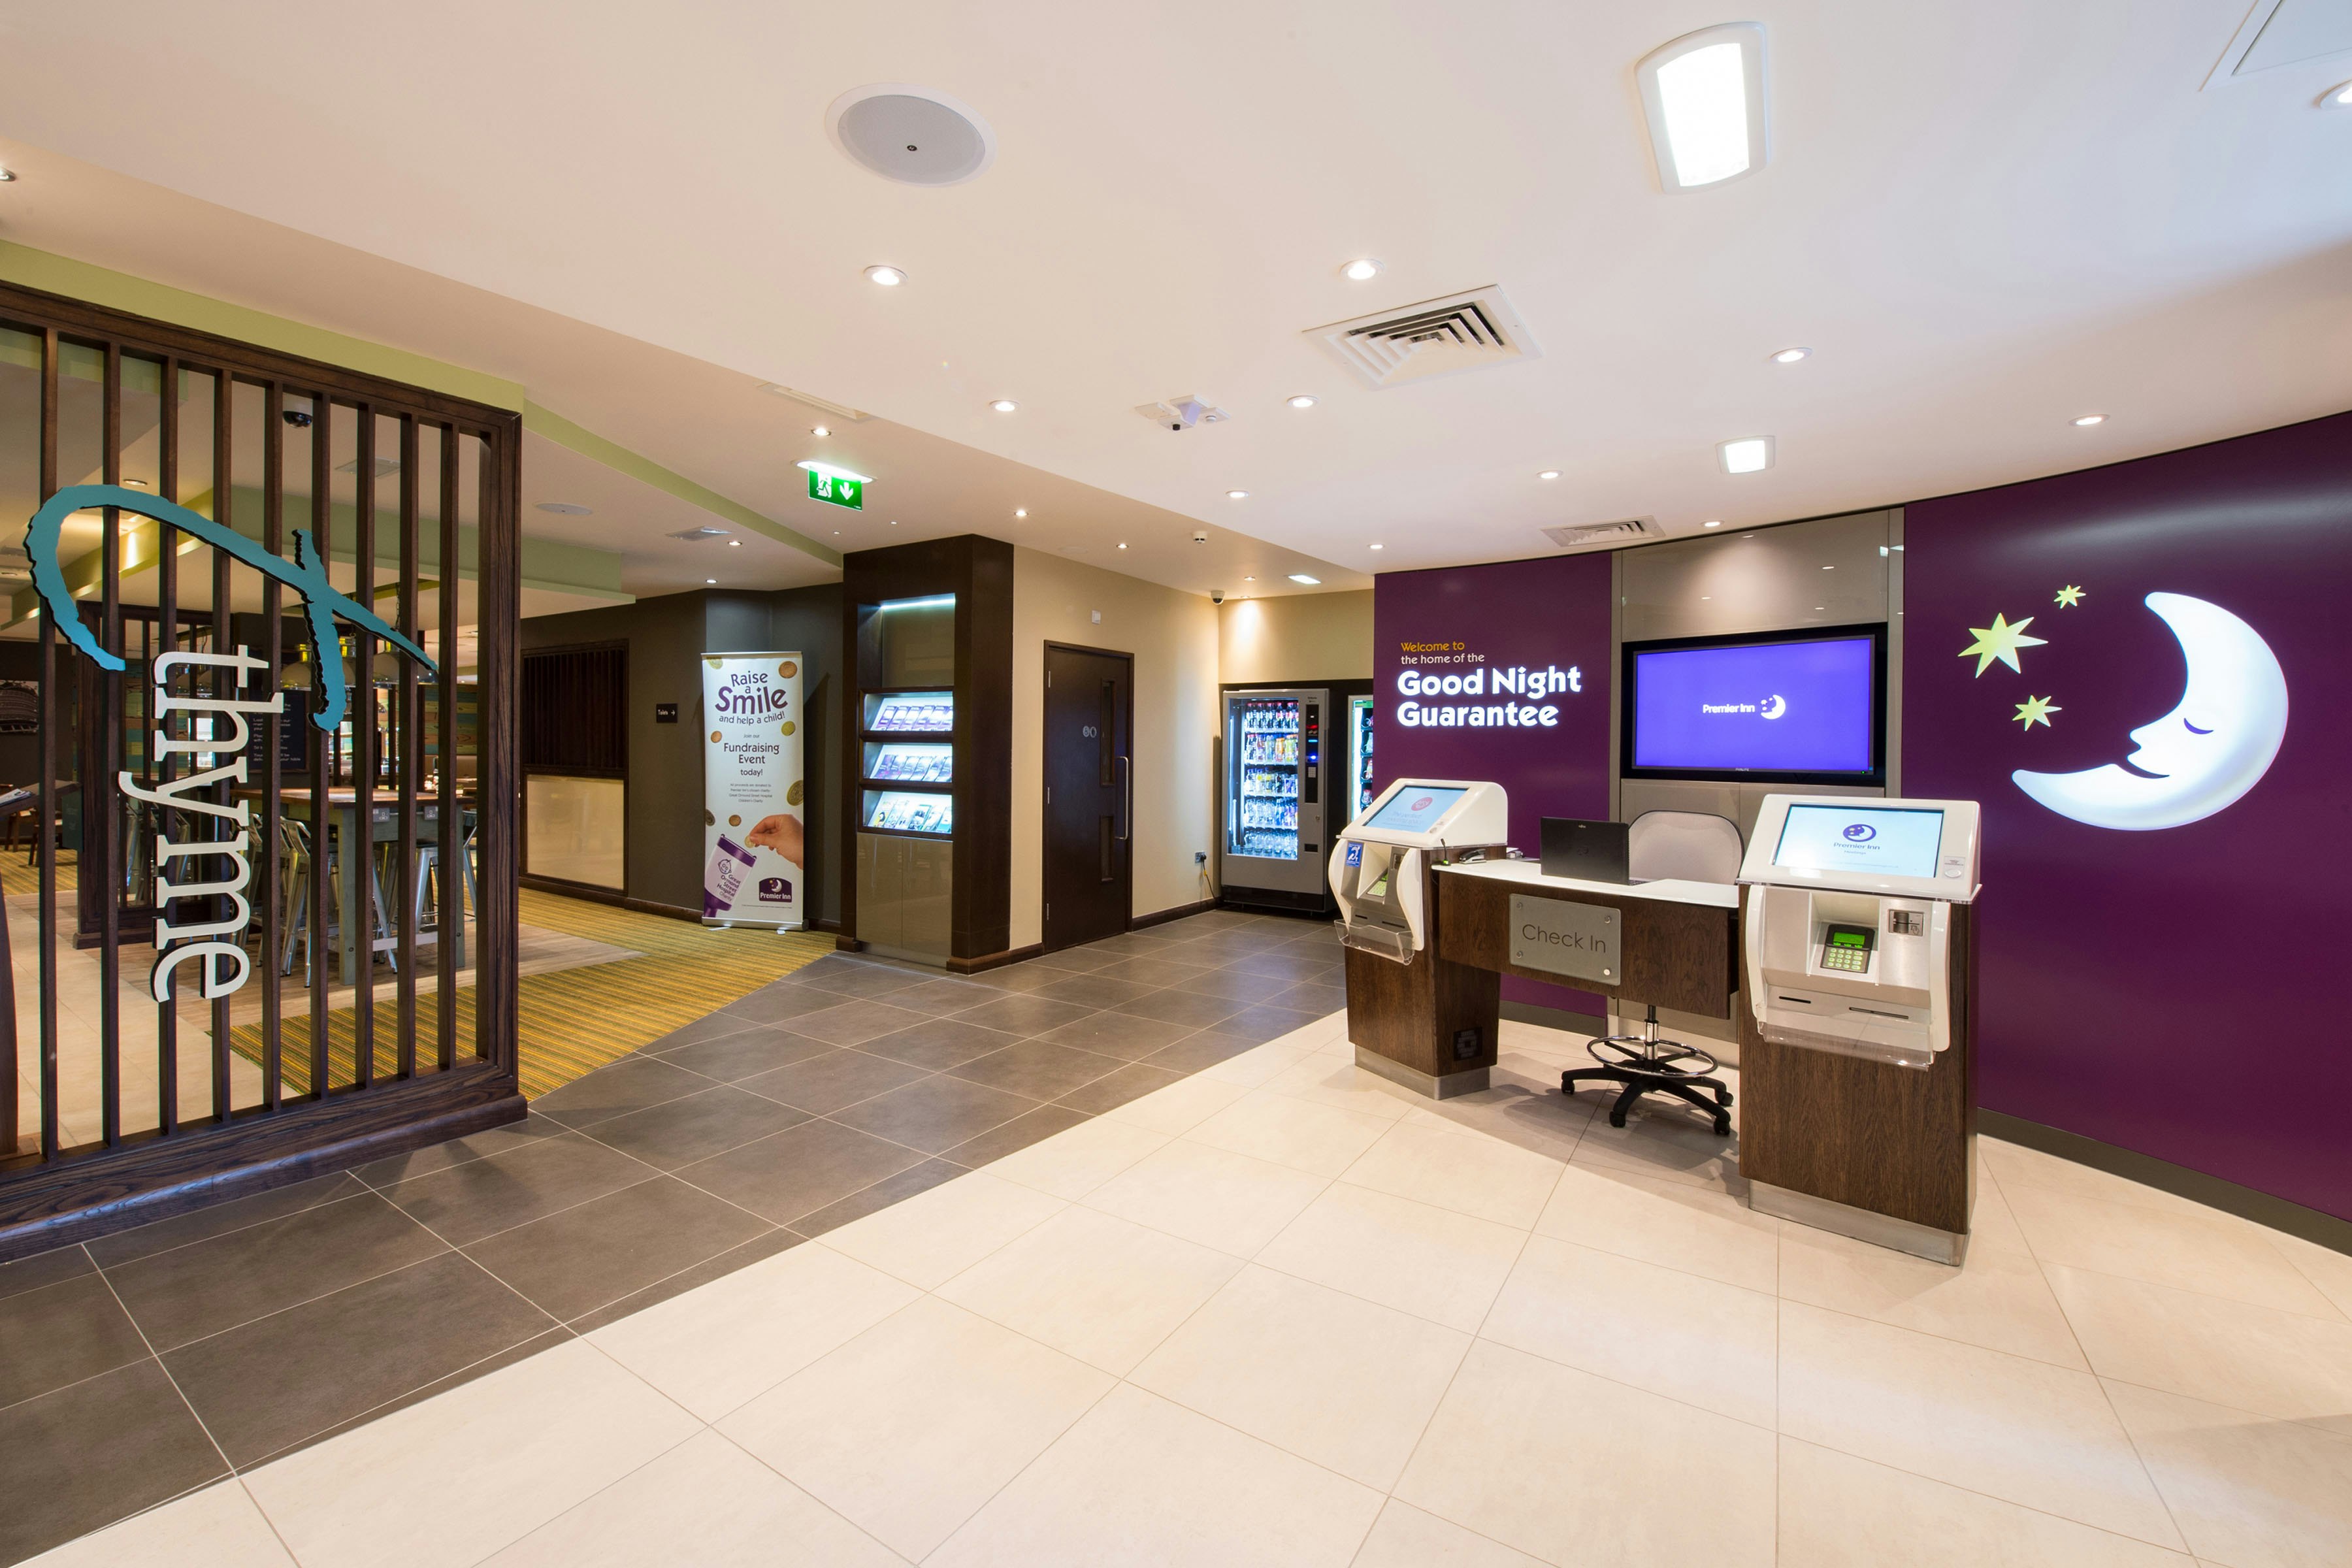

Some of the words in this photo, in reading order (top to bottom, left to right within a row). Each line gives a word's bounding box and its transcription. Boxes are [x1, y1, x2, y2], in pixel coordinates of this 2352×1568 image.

[1401, 642, 1450, 652] Welcome
[1452, 641, 1465, 651] to
[1401, 655, 1418, 664] the
[1420, 655, 1450, 664] home
[1453, 653, 1465, 662] of
[1467, 653, 1485, 662] the
[730, 670, 768, 687] Raise
[1397, 668, 1484, 696] Good
[1492, 666, 1582, 699] Night
[715, 686, 788, 715] Smile
[1397, 702, 1560, 727] Guarantee
[1703, 704, 1739, 713] Premier
[1740, 703, 1756, 713] Inn
[719, 715, 734, 724] and
[736, 717, 754, 726] help
[764, 710, 785, 723] child!
[723, 743, 779, 755] Fundraising
[738, 754, 766, 764] Event
[740, 768, 763, 777] today!
[118, 645, 284, 1003] thyme
[721, 875, 740, 889] Ormond
[728, 874, 741, 884] Great
[717, 883, 736, 897] Hospital
[723, 882, 738, 893] Street
[1522, 924, 1584, 949] Check
[1590, 935, 1606, 953] In
